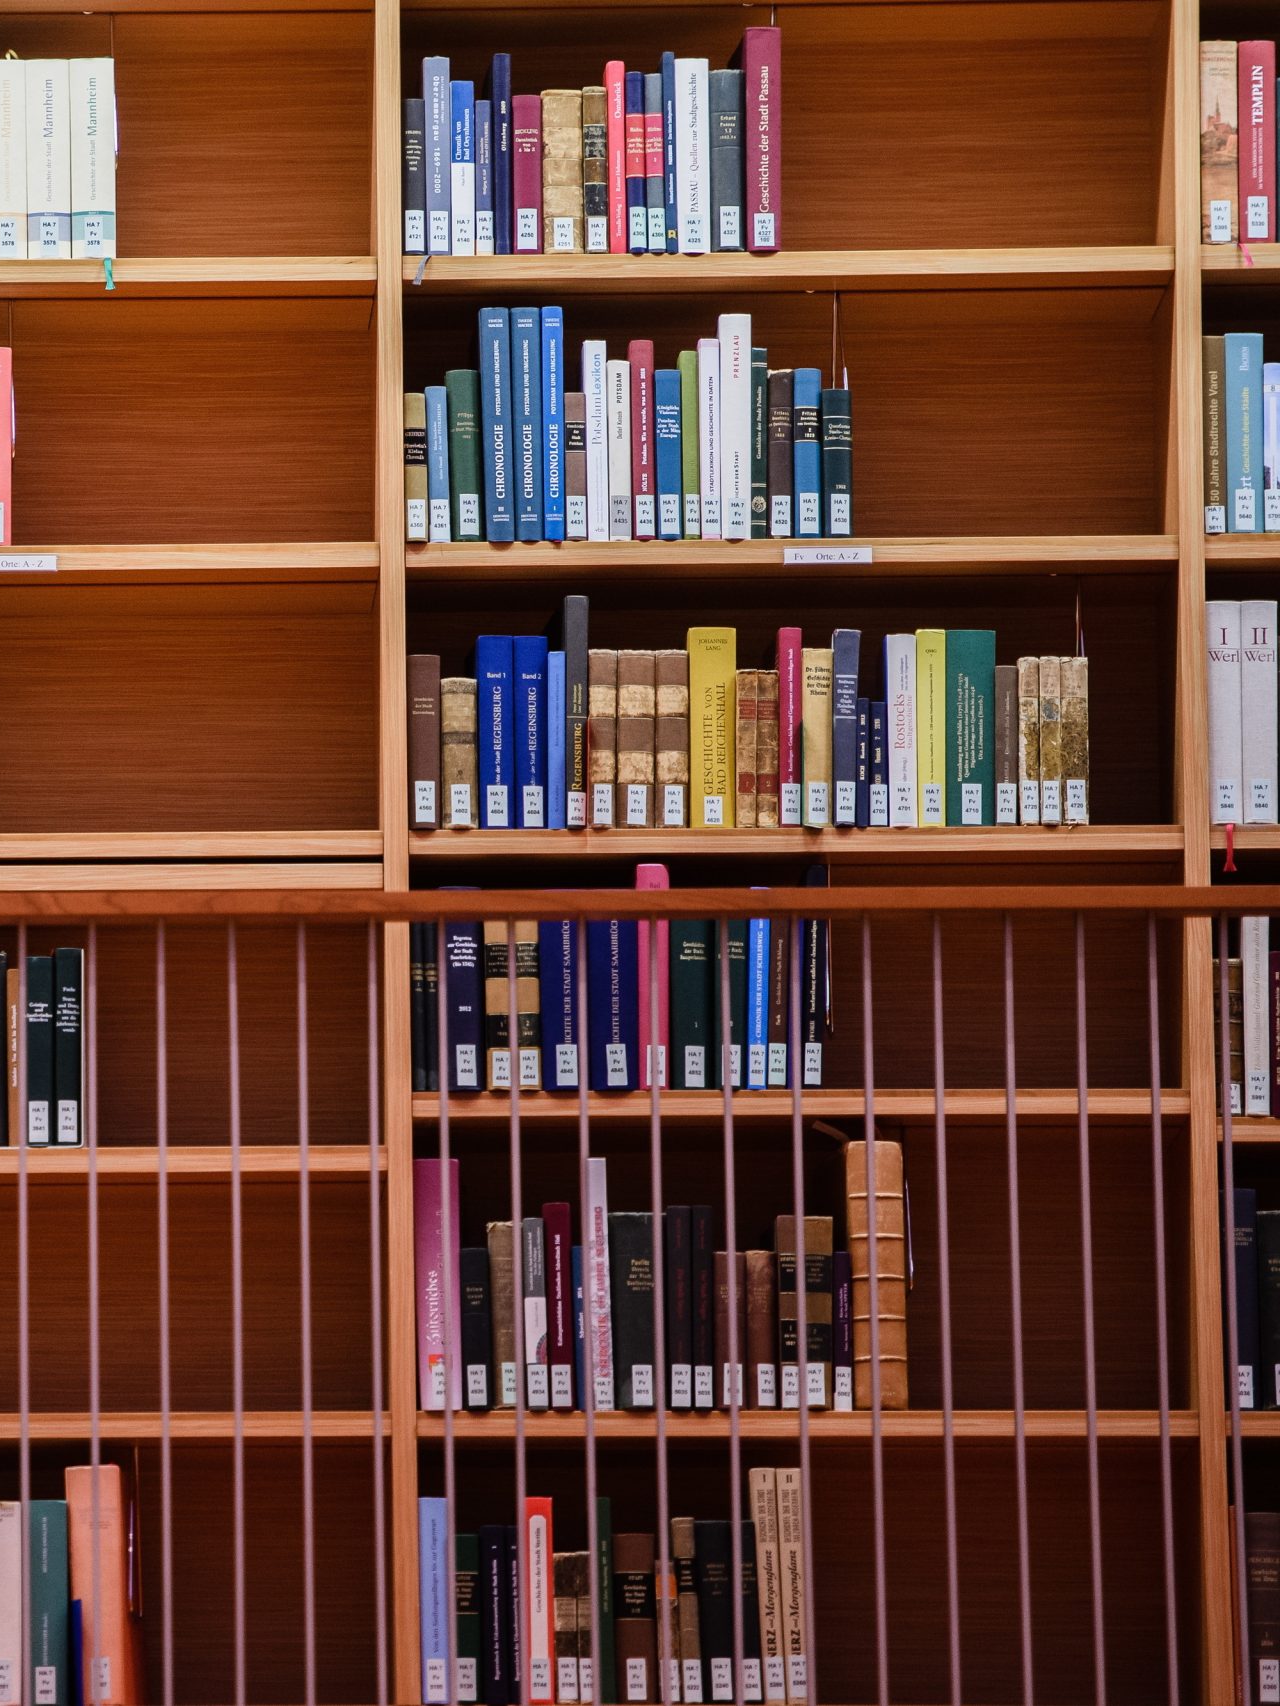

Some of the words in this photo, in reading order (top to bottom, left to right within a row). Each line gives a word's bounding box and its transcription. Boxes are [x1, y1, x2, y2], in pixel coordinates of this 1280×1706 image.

[87, 77, 96, 136] Mannheim
[614, 82, 622, 118] Osnabrück
[689, 72, 698, 128] Stadtgeschichte
[758, 66, 769, 101] Passau
[1252, 65, 1263, 125] TEMPLIN
[43, 79, 53, 138] Mannheim
[432, 75, 440, 141] Oberammergau
[463, 108, 471, 147] Oeynhausen
[758, 104, 769, 132] Stadt
[690, 143, 699, 171] Quellen
[759, 134, 769, 152] der
[690, 181, 699, 213] PASSAU
[759, 154, 769, 213] Geschichte
[1209, 370, 1218, 396] Varel
[1210, 398, 1219, 456] Stadtrechte
[494, 424, 505, 499] CHRONOLOGIE
[522, 424, 533, 499] CHRONOLOGIE
[1210, 459, 1219, 487] Jahre
[23, 560, 30, 568] A
[37, 560, 43, 568] Z
[853, 552, 859, 560] Z
[1208, 650, 1239, 662] Werl
[1220, 628, 1228, 645] I
[1244, 650, 1275, 663] Werl
[1251, 628, 1268, 645] II
[493, 685, 502, 750] REGENSBURG
[528, 687, 537, 751] REGENSBURG
[716, 682, 726, 764] REICHENHALL
[894, 694, 905, 750] Rostocks
[703, 714, 713, 794] GESCHICHTE
[717, 769, 726, 794] BAD
[763, 1550, 777, 1621] Morgenglanz
[788, 1550, 801, 1622] Morgenglanz
